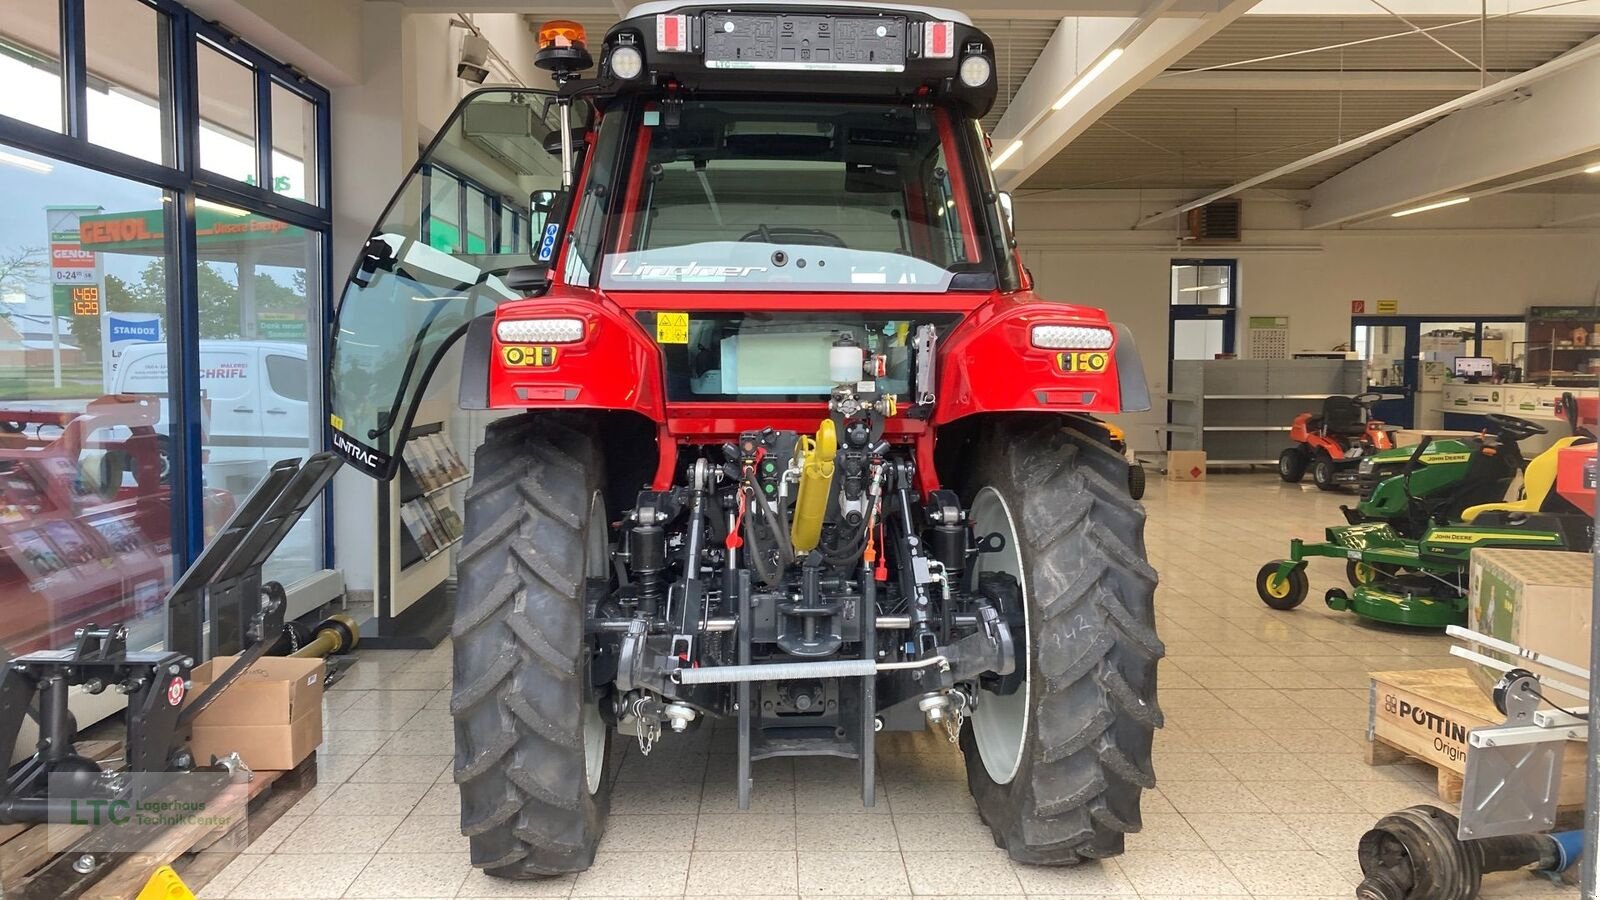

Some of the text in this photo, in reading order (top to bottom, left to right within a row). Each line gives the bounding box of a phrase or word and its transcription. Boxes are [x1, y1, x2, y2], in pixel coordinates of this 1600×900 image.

[80, 218, 149, 244] GENOL
[53, 249, 94, 259] GENOL
[612, 259, 768, 277] Lindner
[113, 326, 155, 335] STANDOX
[333, 433, 378, 468] LINTRAC
[1400, 700, 1470, 745] PÖTTIN
[1433, 737, 1467, 763] Origin
